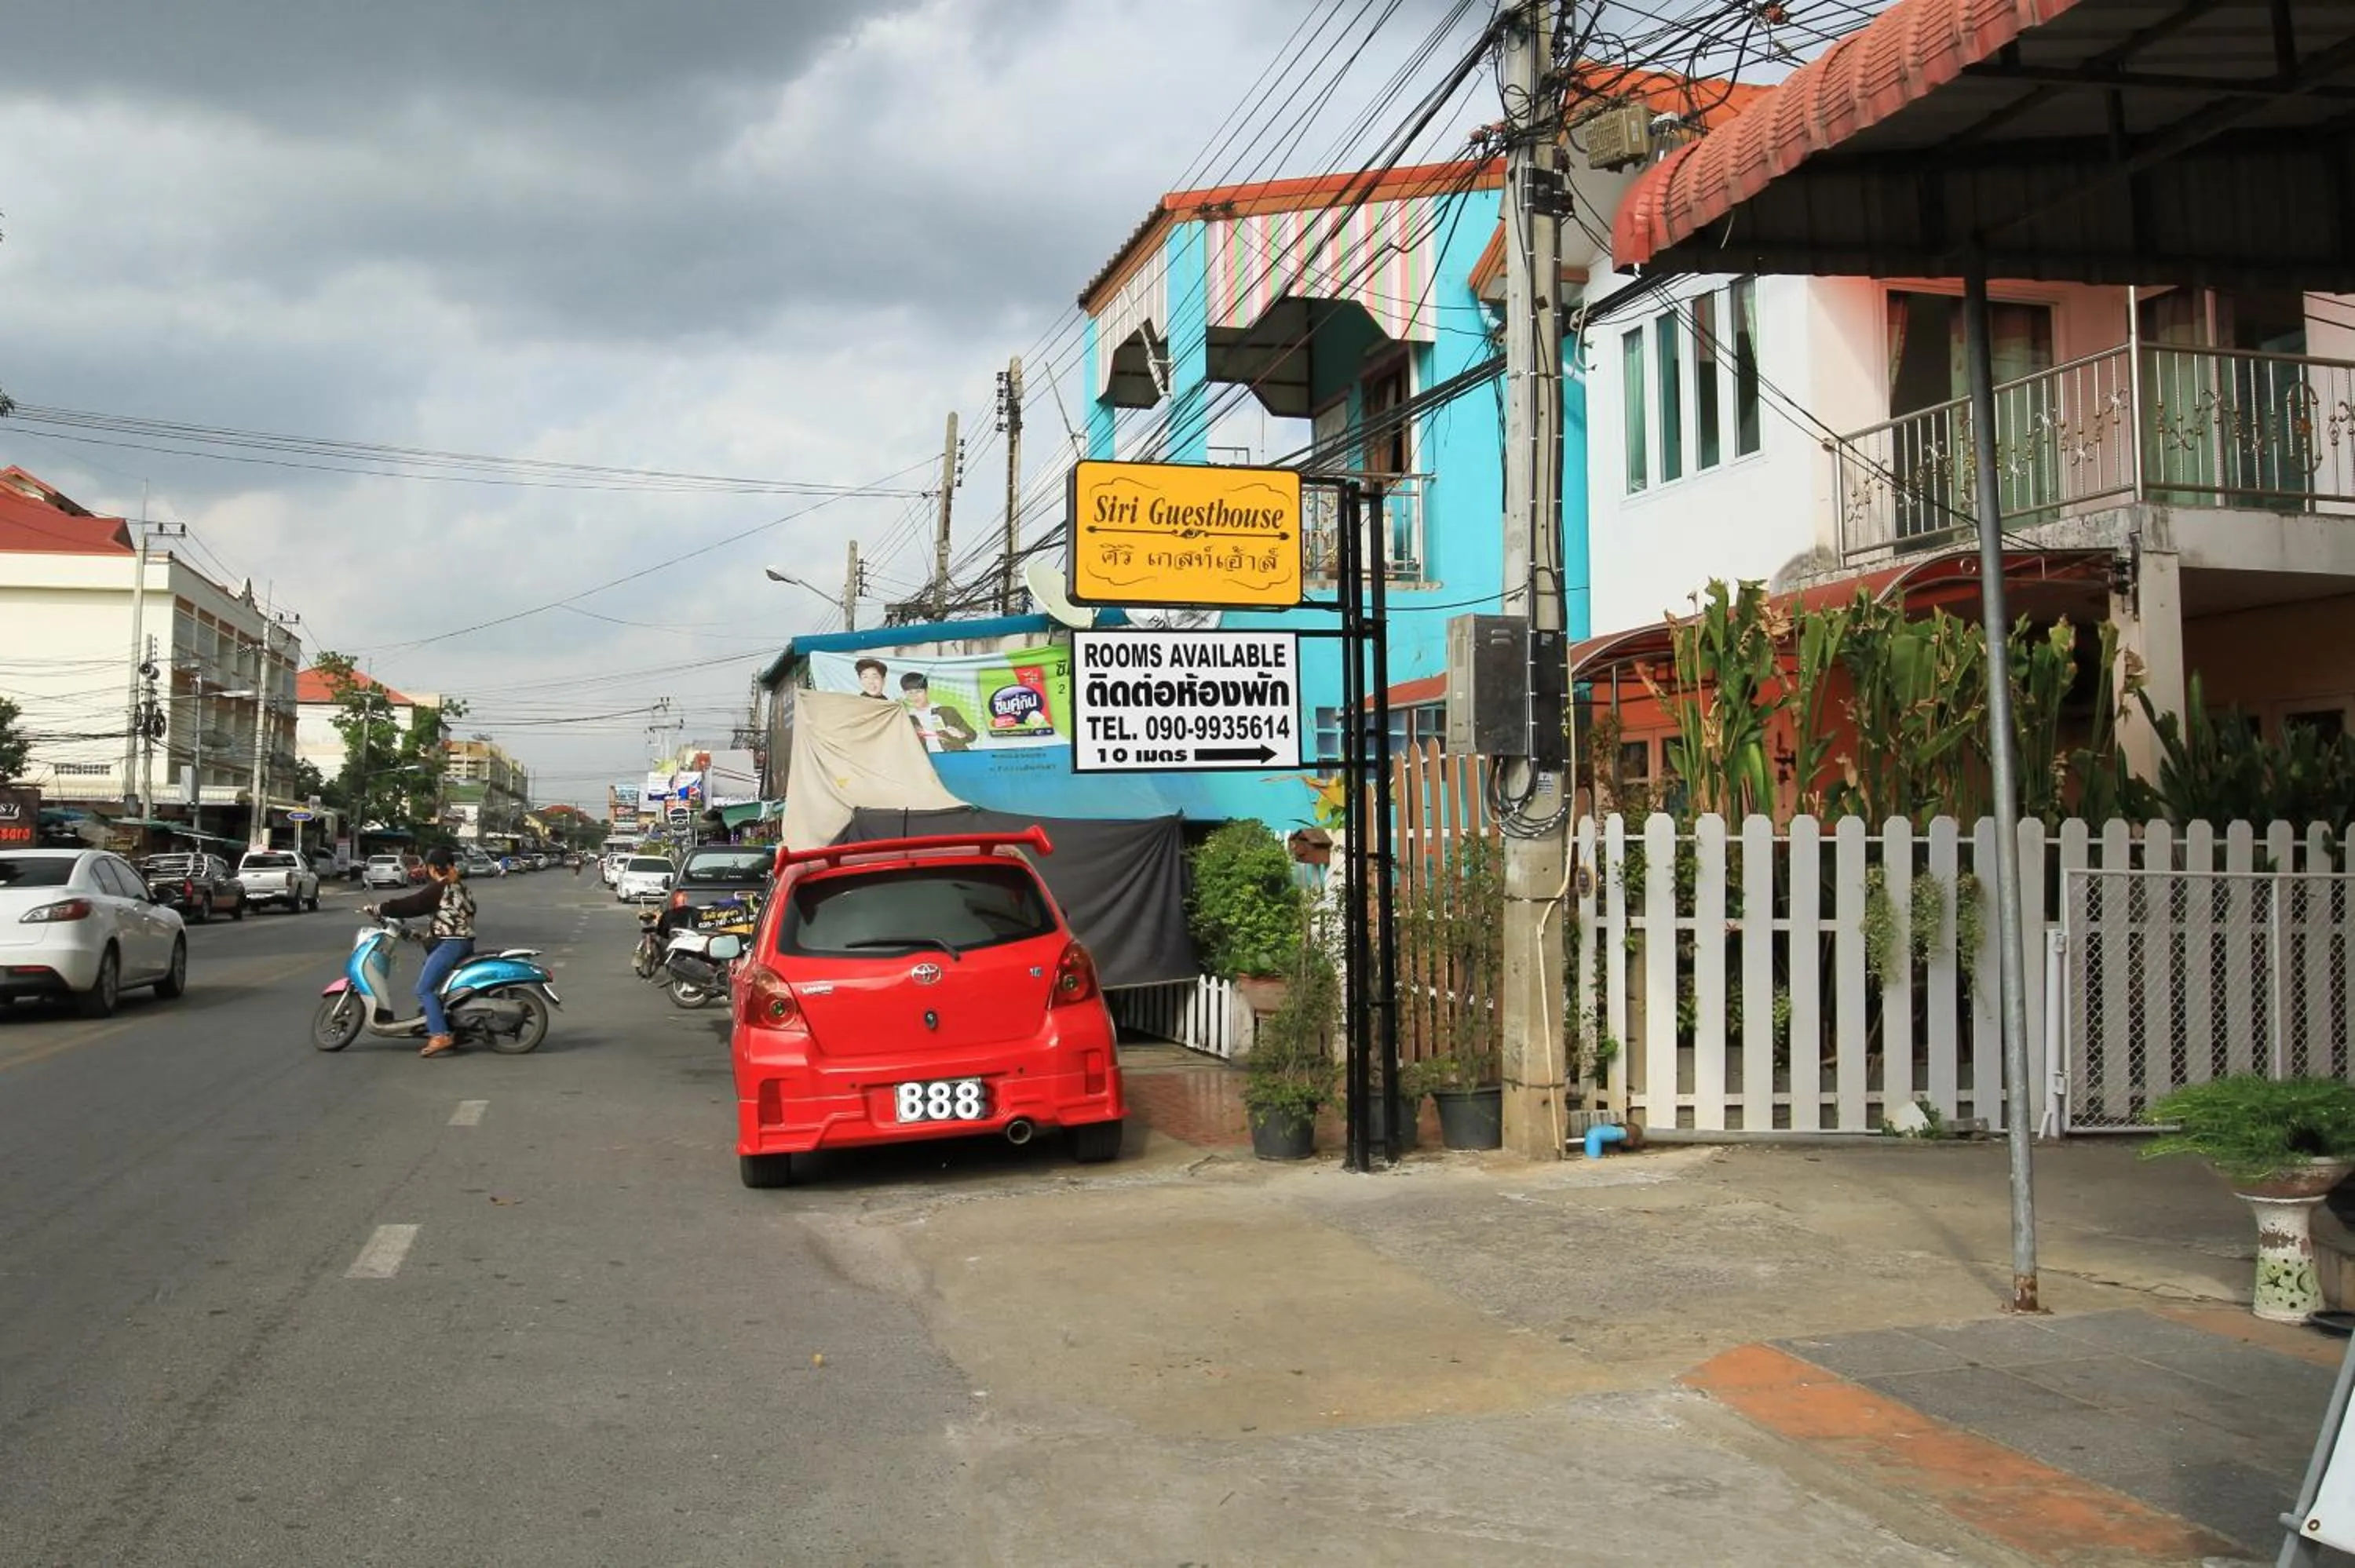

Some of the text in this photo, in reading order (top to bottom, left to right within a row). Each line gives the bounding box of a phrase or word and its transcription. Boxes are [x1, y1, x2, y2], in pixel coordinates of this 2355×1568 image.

[1094, 494, 1285, 530] Siri Guesthouse
[1083, 643, 1287, 668] ROOMS AVAILABLE
[1085, 671, 1291, 707] ติดต่อห้องพัก
[1086, 714, 1291, 741] TEL. 090-9935614
[1136, 748, 1188, 763] เมตร
